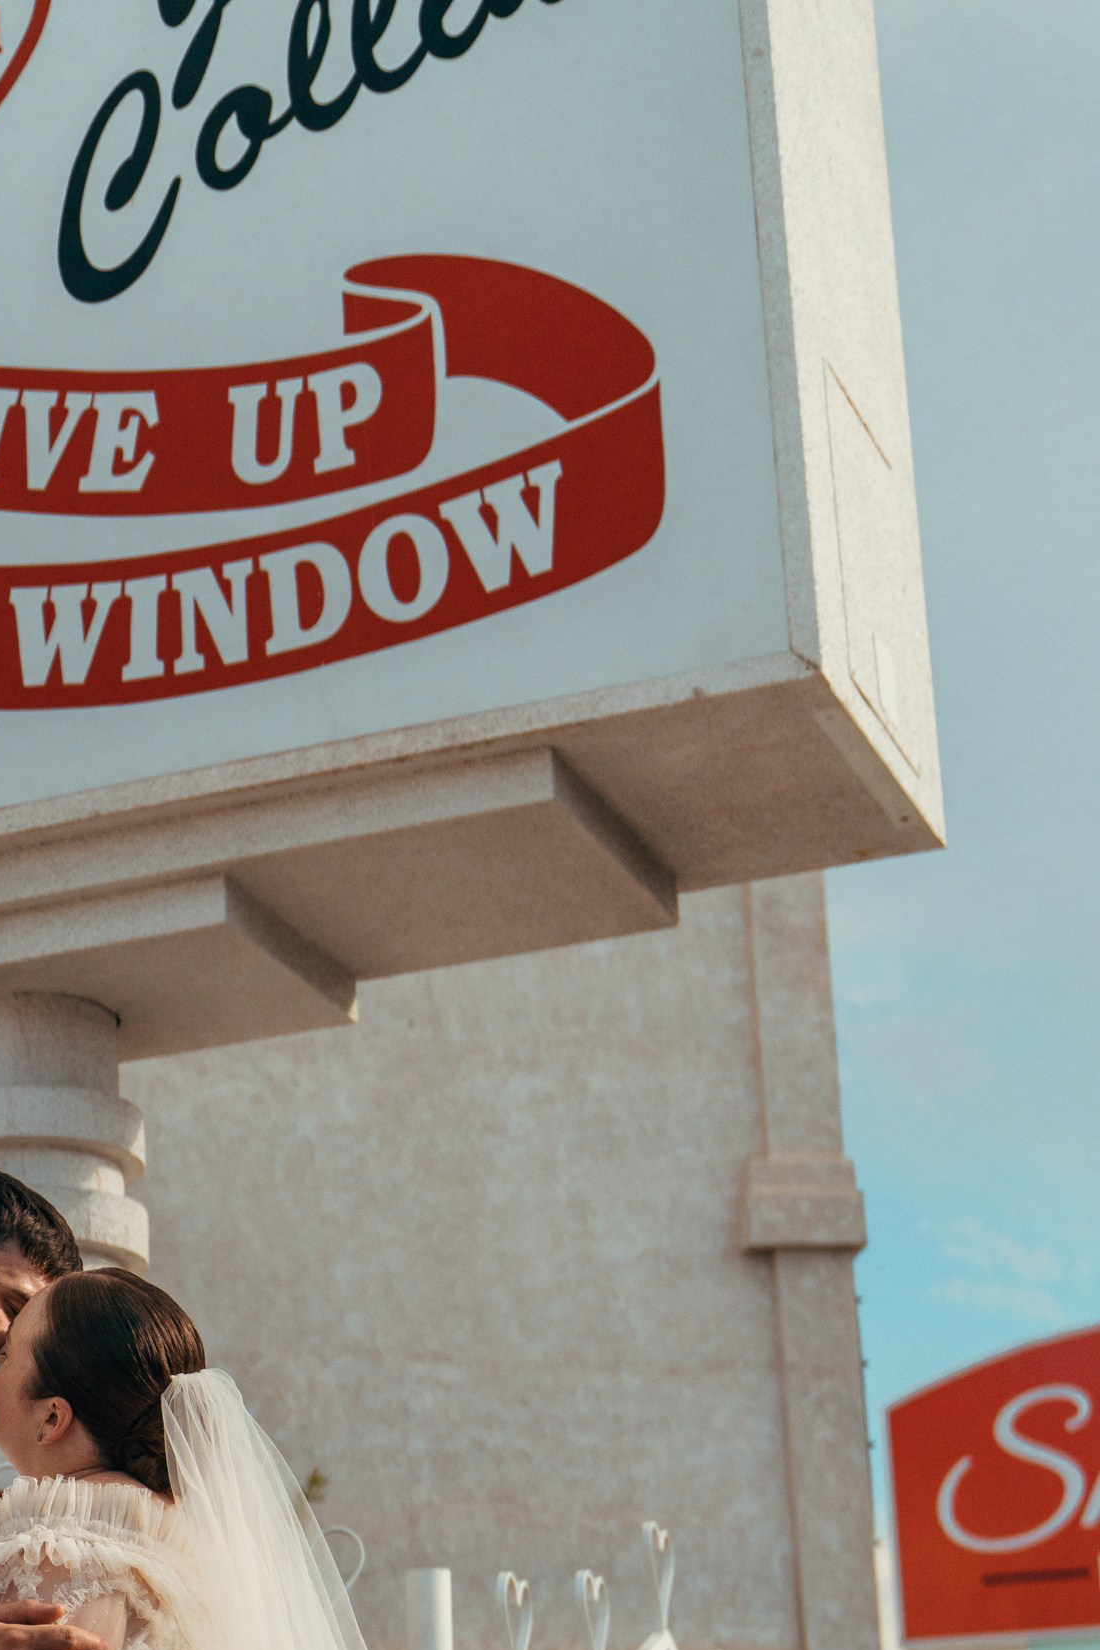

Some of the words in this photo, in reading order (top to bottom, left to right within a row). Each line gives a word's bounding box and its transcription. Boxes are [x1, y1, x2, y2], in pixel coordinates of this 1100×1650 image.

[58, 0, 564, 303] Coll
[228, 361, 383, 485] UP
[8, 459, 563, 687] WINDOW
[936, 1383, 1100, 1554] S
